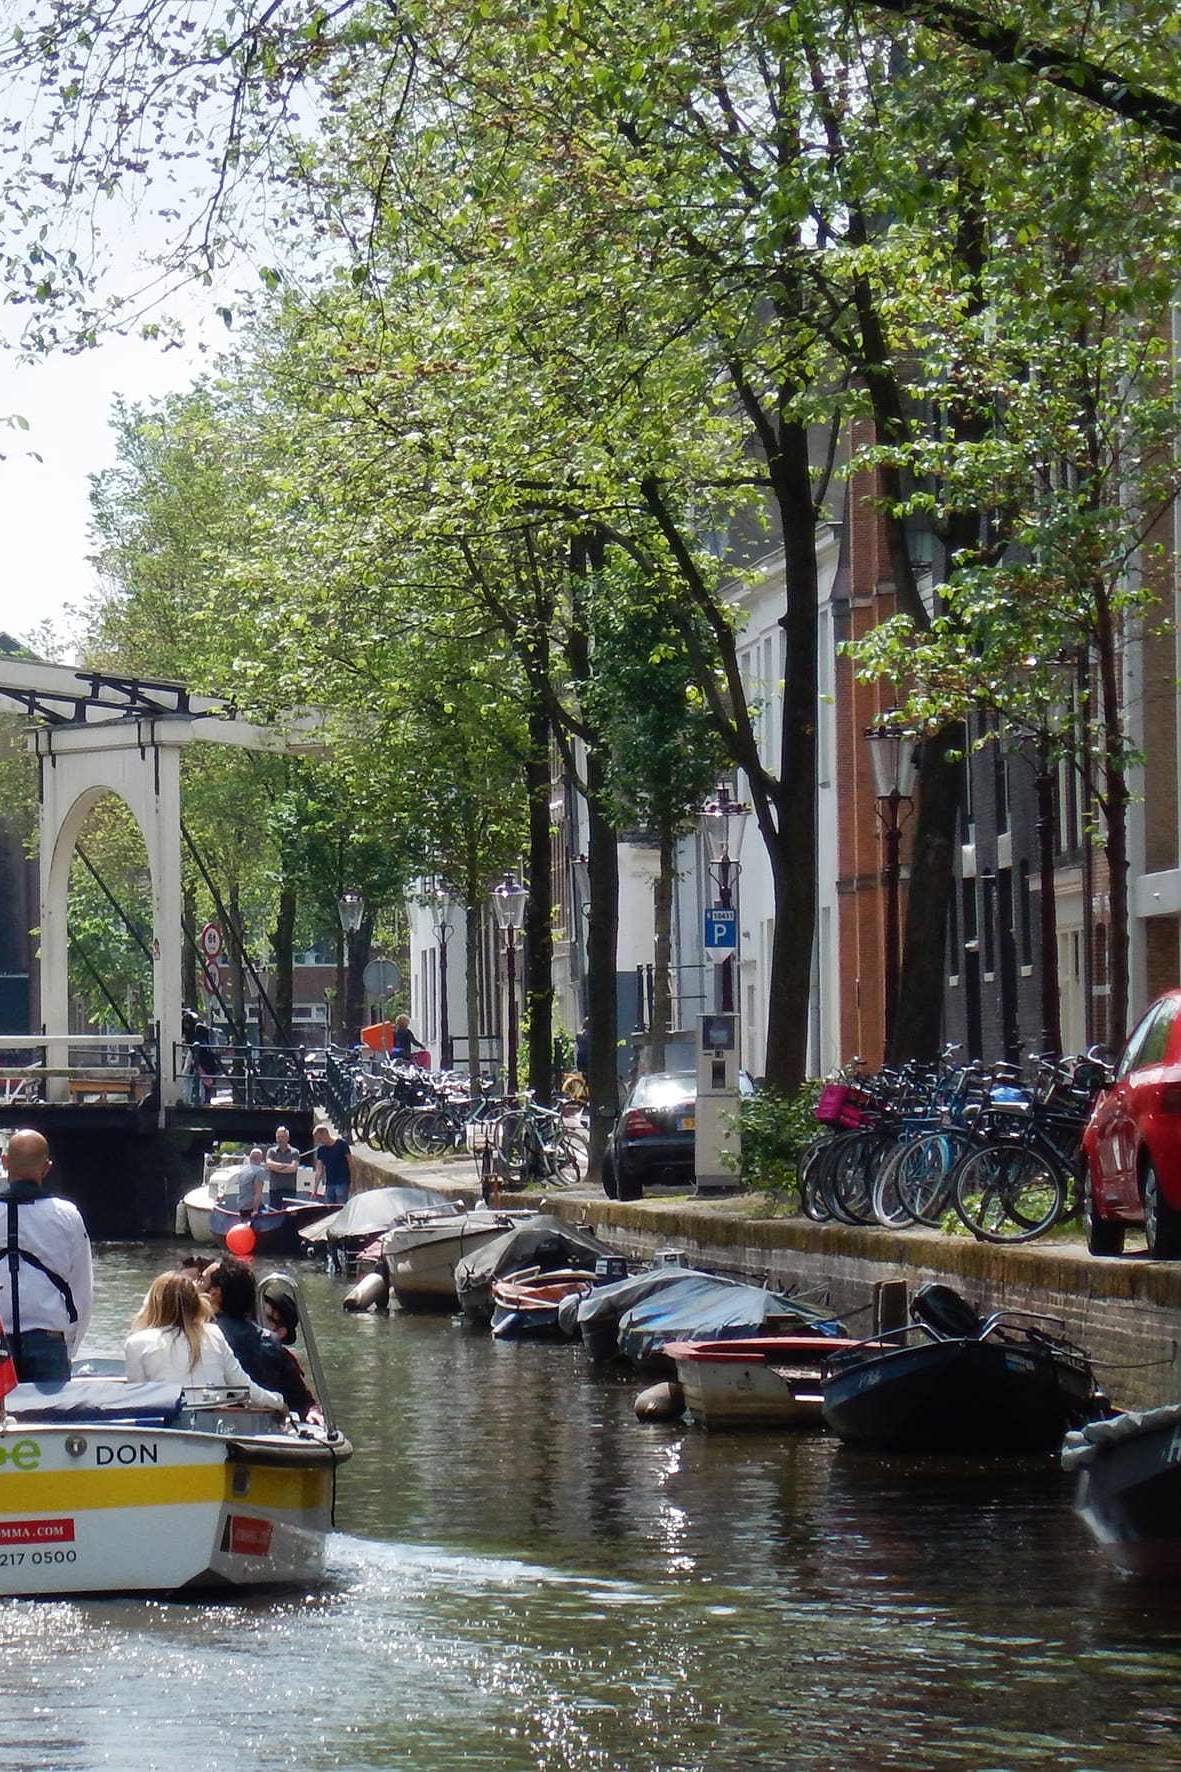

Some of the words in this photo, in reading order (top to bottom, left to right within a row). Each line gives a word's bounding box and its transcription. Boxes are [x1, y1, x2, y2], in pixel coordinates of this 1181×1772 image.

[714, 924, 727, 944] P
[96, 1444, 158, 1465] DON
[0, 1553, 26, 1567] 217
[31, 1550, 77, 1565] 0500
